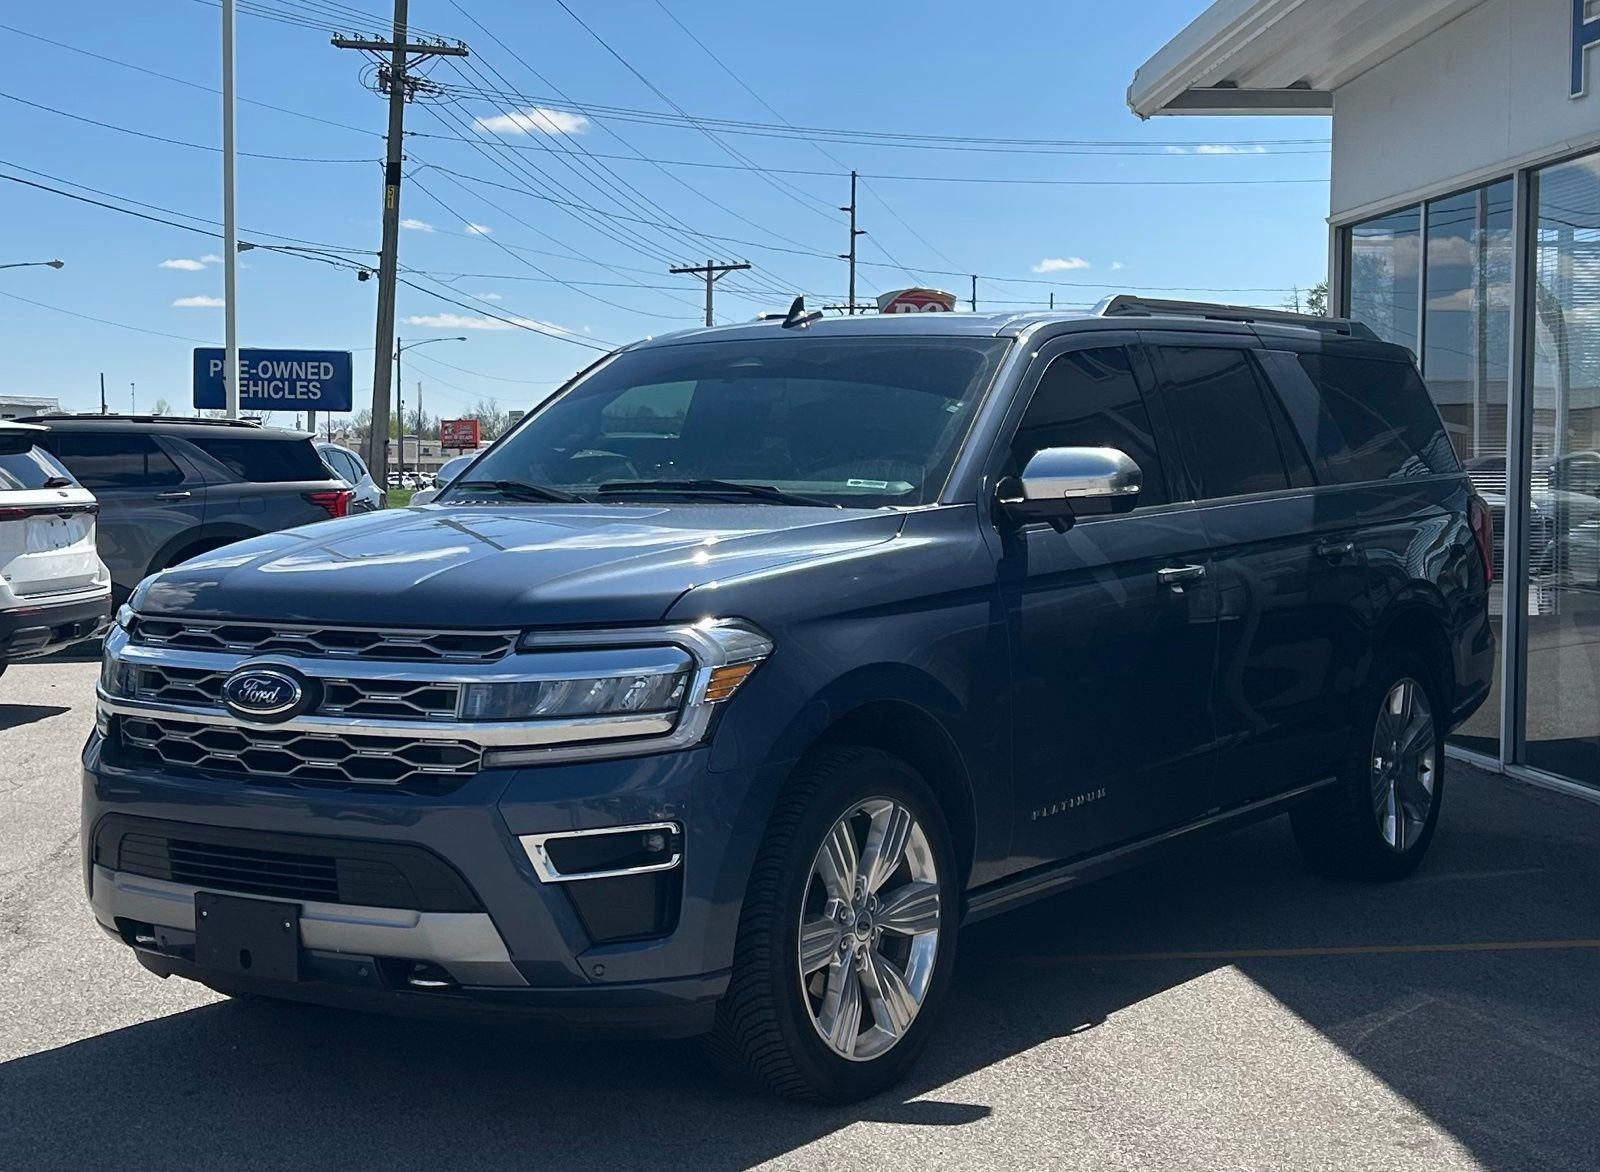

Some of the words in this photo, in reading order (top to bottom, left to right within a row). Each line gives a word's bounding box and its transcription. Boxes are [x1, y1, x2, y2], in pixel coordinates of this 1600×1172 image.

[388, 186, 394, 208] 51
[209, 359, 334, 380] PE-OWNED
[223, 380, 321, 400] EHICLES
[239, 678, 281, 704] Ford
[1031, 787, 1107, 821] PLATINUM
